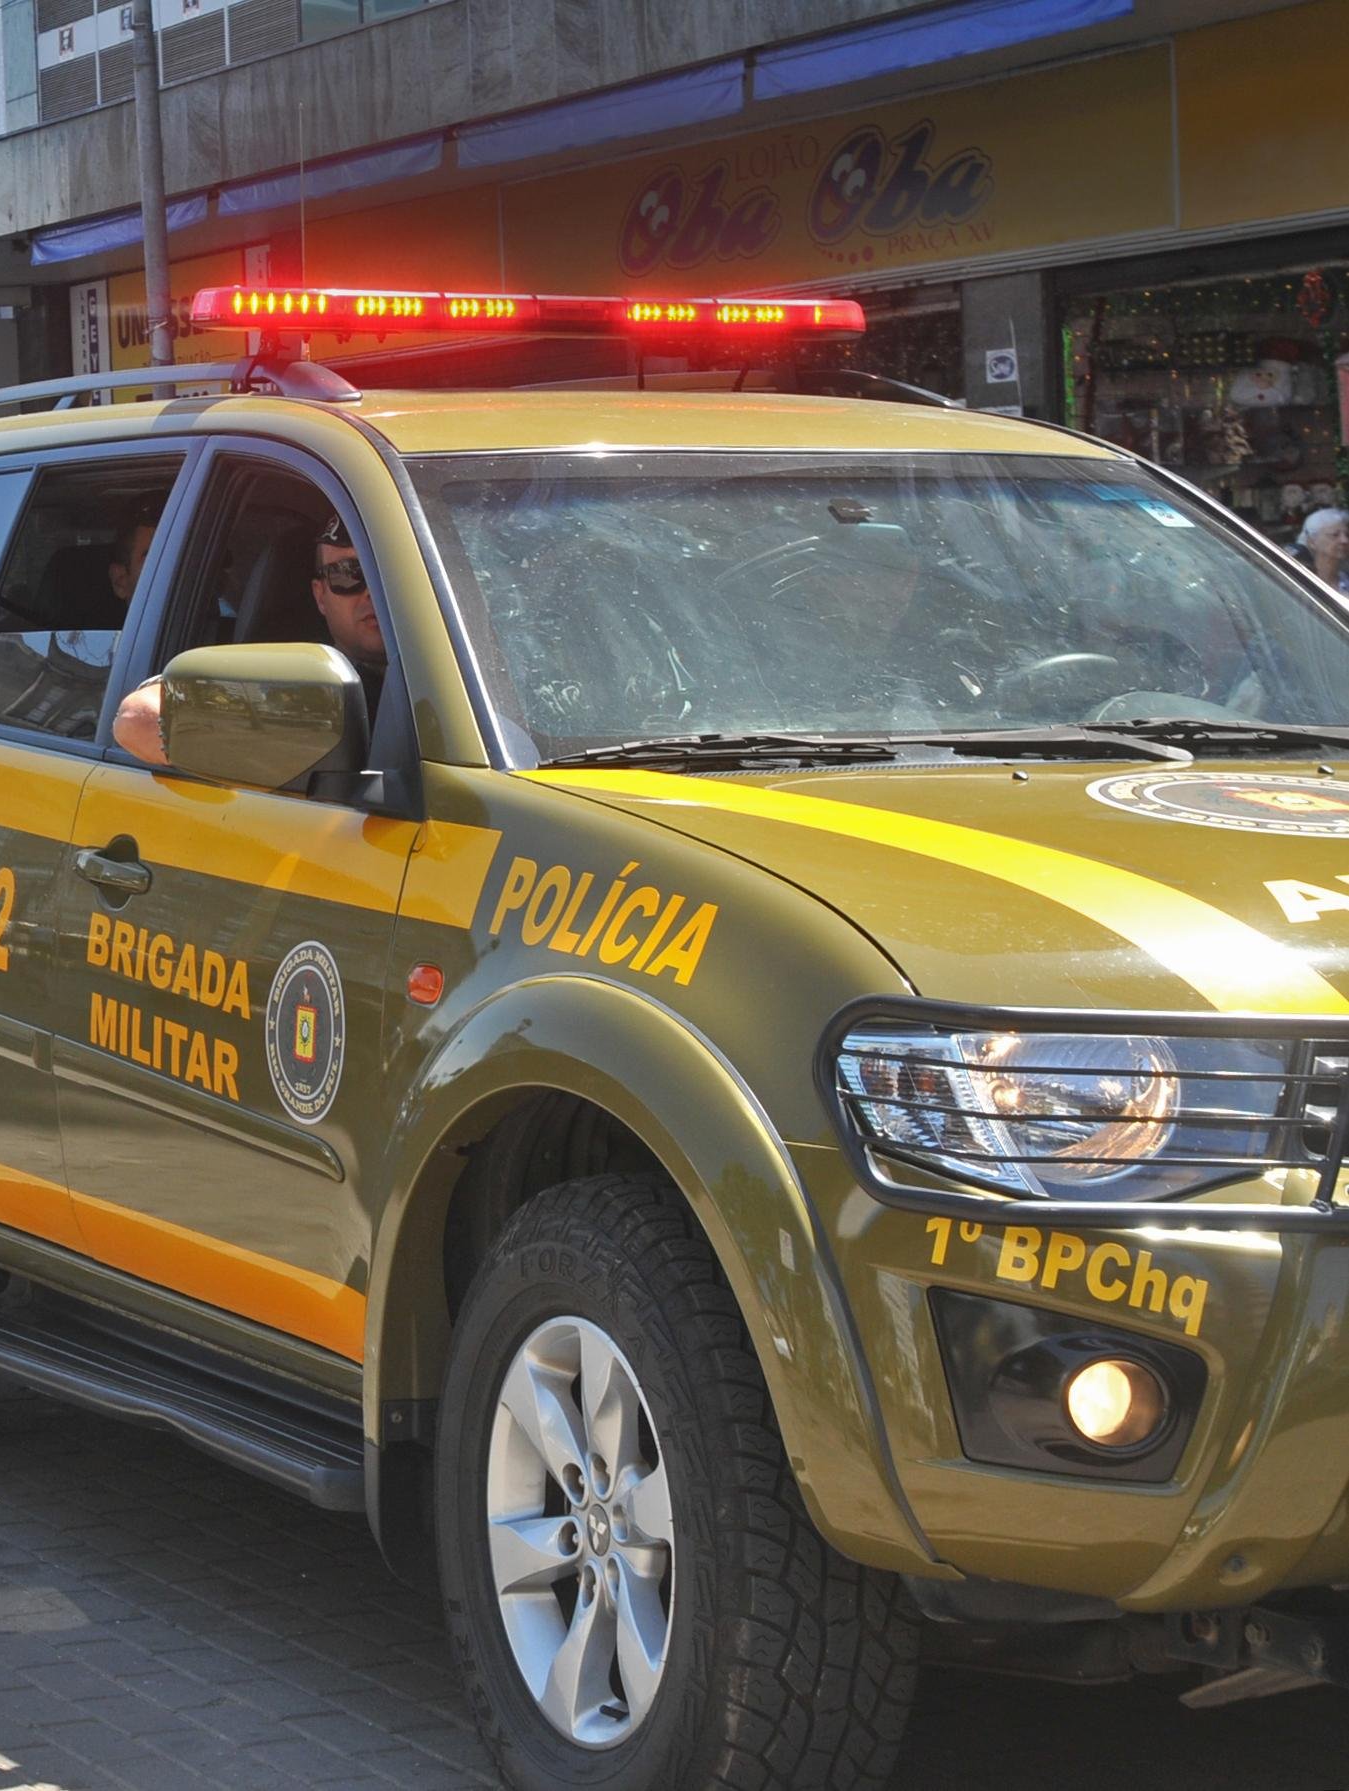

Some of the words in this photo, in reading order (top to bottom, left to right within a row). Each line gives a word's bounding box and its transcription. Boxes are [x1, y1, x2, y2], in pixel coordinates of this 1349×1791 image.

[618, 160, 781, 278] Oba
[806, 119, 994, 244] Oba
[887, 228, 958, 257] PRAÇA
[86, 912, 252, 1020] BRIGADA
[489, 857, 719, 986] POLÍCIA
[89, 992, 240, 1101] MILITAR
[996, 1225, 1209, 1337] BPChq
